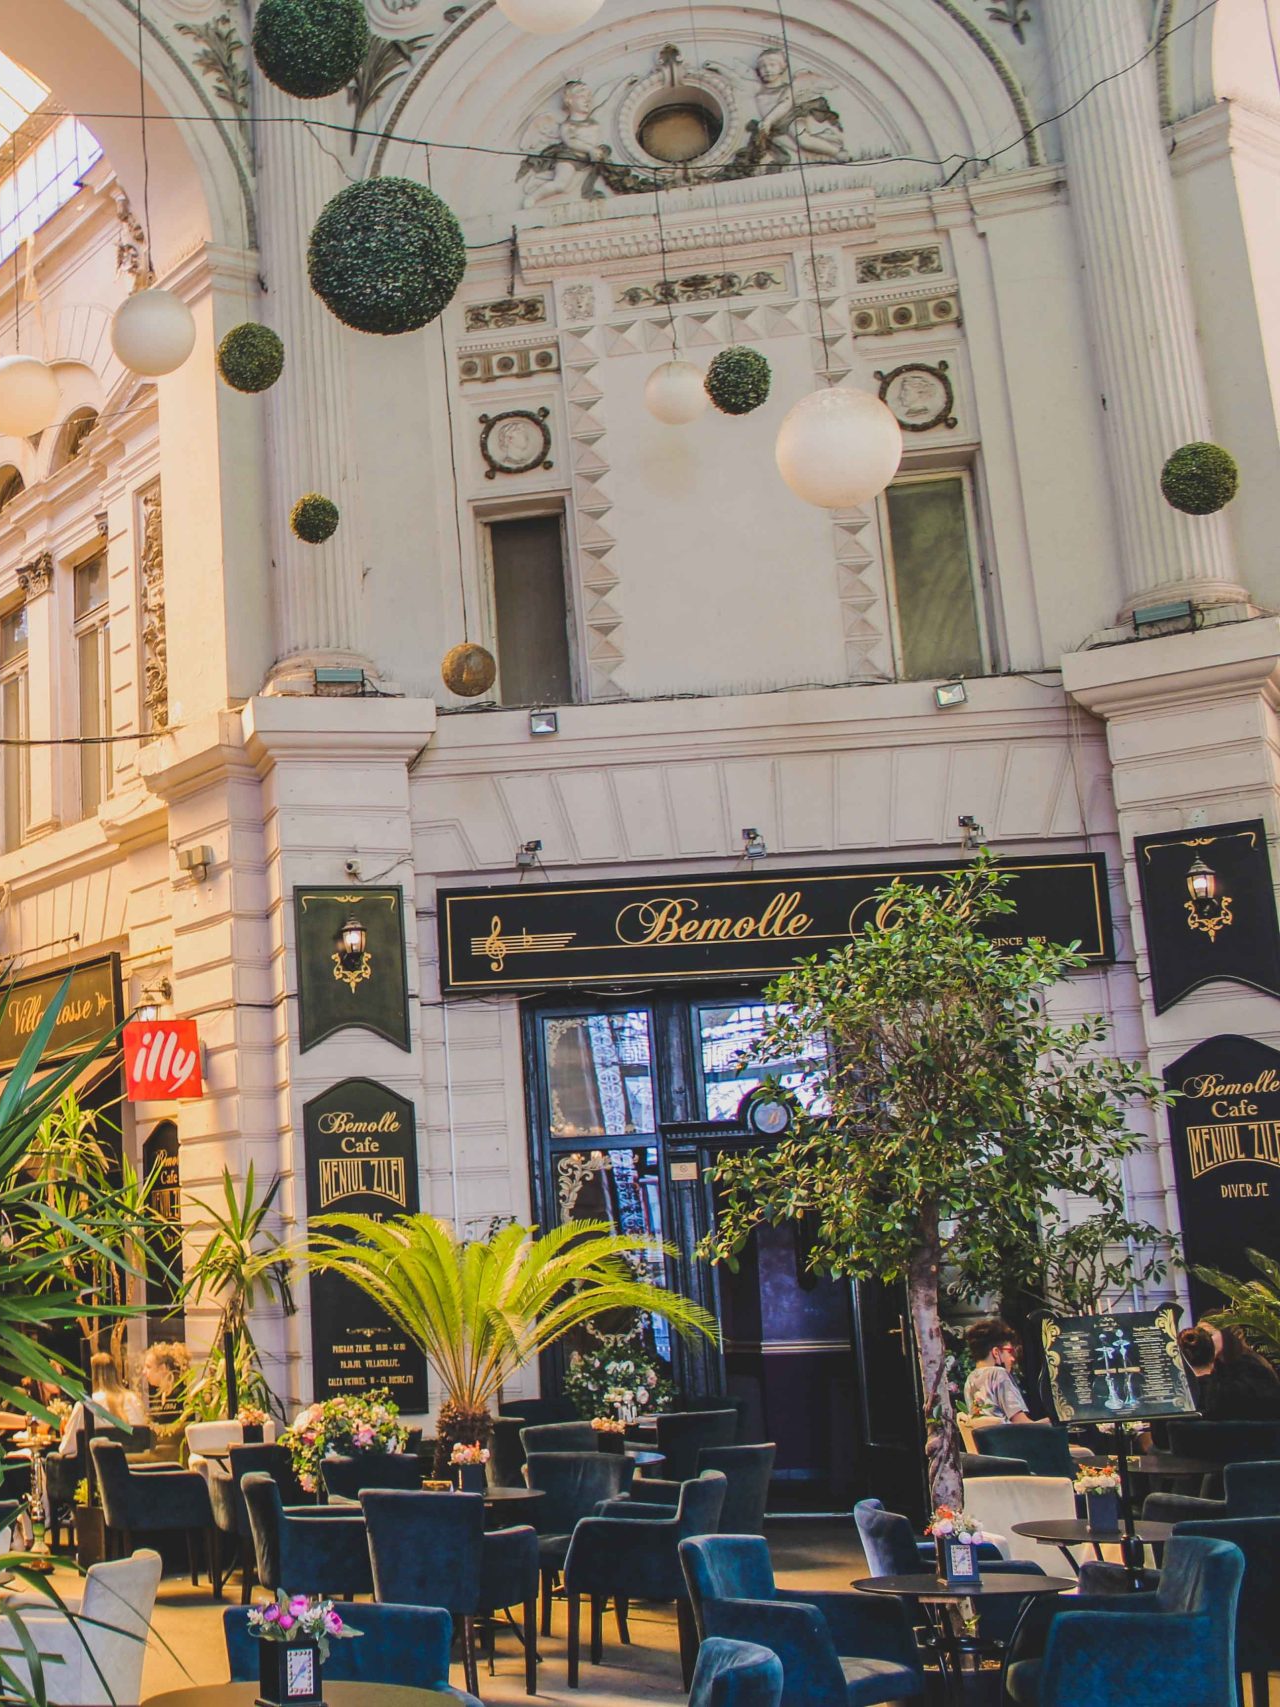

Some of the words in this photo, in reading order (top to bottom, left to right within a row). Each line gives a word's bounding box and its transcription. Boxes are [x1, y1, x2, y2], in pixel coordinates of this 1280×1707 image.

[616, 891, 814, 945] Bemolle
[991, 937, 1023, 948] SINCE
[133, 1030, 196, 1093] illy
[1182, 1069, 1280, 1098] Bemolle
[1211, 1099, 1259, 1118] Cafe
[318, 1111, 403, 1134] Bemolle
[341, 1137, 380, 1153] Cafe
[1190, 1125, 1246, 1174] MENIUL
[322, 1160, 367, 1206] MENIUL
[370, 1159, 405, 1206] ZILEI
[1221, 1182, 1269, 1198] DIVERSE
